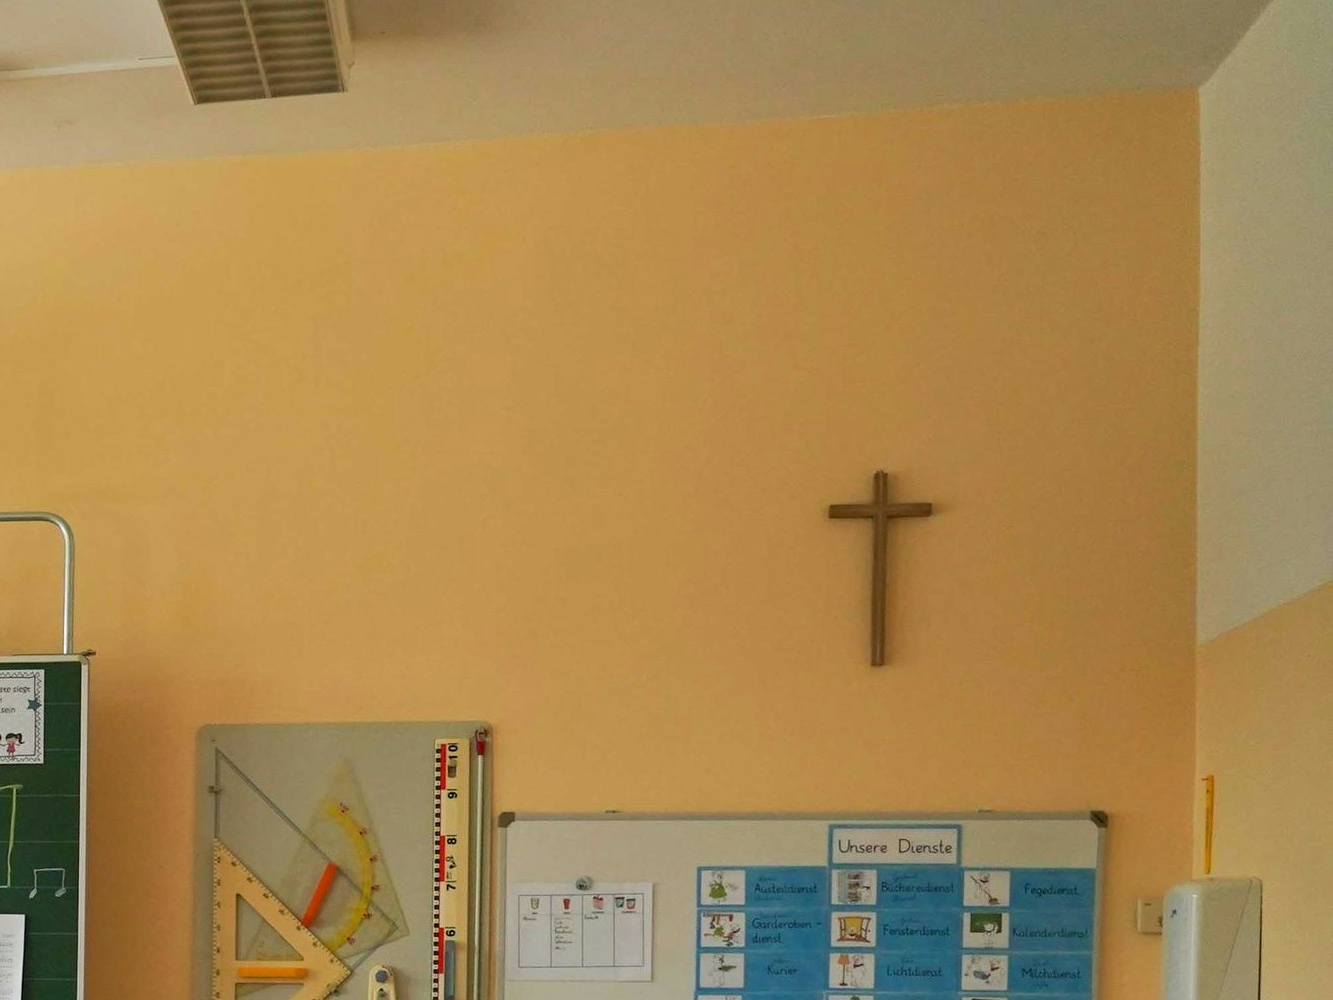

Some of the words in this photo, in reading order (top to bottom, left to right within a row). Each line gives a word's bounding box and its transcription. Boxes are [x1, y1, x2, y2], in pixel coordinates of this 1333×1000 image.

[13, 685, 31, 694] siegt
[446, 837, 457, 845] 8
[838, 839, 888, 854] Unsere
[898, 838, 953, 854] Dienste
[446, 883, 456, 892] 7
[754, 882, 818, 894] Austeildienst
[1024, 883, 1079, 897] Fegedienst
[751, 917, 813, 929] Garderoben
[883, 924, 950, 937] Fensterdienst
[1012, 927, 1089, 939] Kalenderdienst
[751, 935, 782, 944] dienst
[767, 965, 798, 976] Kurier
[886, 967, 943, 977] Lichtdienst
[1021, 968, 1082, 979] Milchdienst
